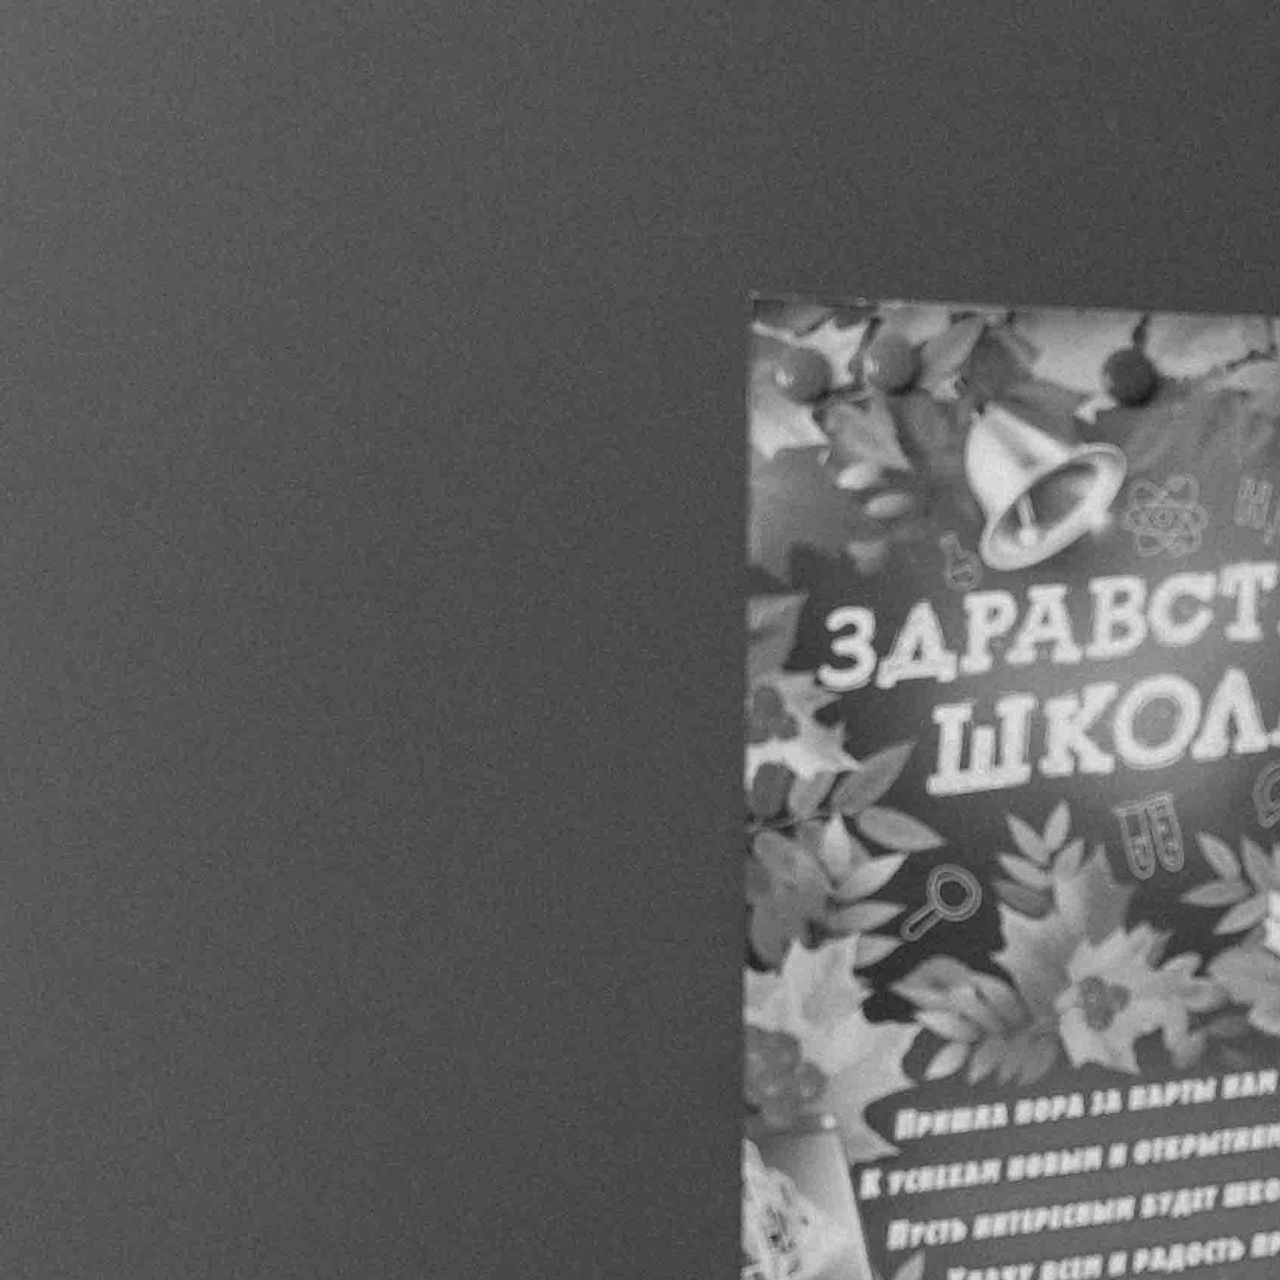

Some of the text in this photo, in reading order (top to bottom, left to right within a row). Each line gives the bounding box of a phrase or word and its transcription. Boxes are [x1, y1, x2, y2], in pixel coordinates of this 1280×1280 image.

[1090, 1088, 1122, 1117] ЗА
[860, 1168, 882, 1200] К
[1107, 1142, 1128, 1169] И
[1107, 1250, 1129, 1278] И
